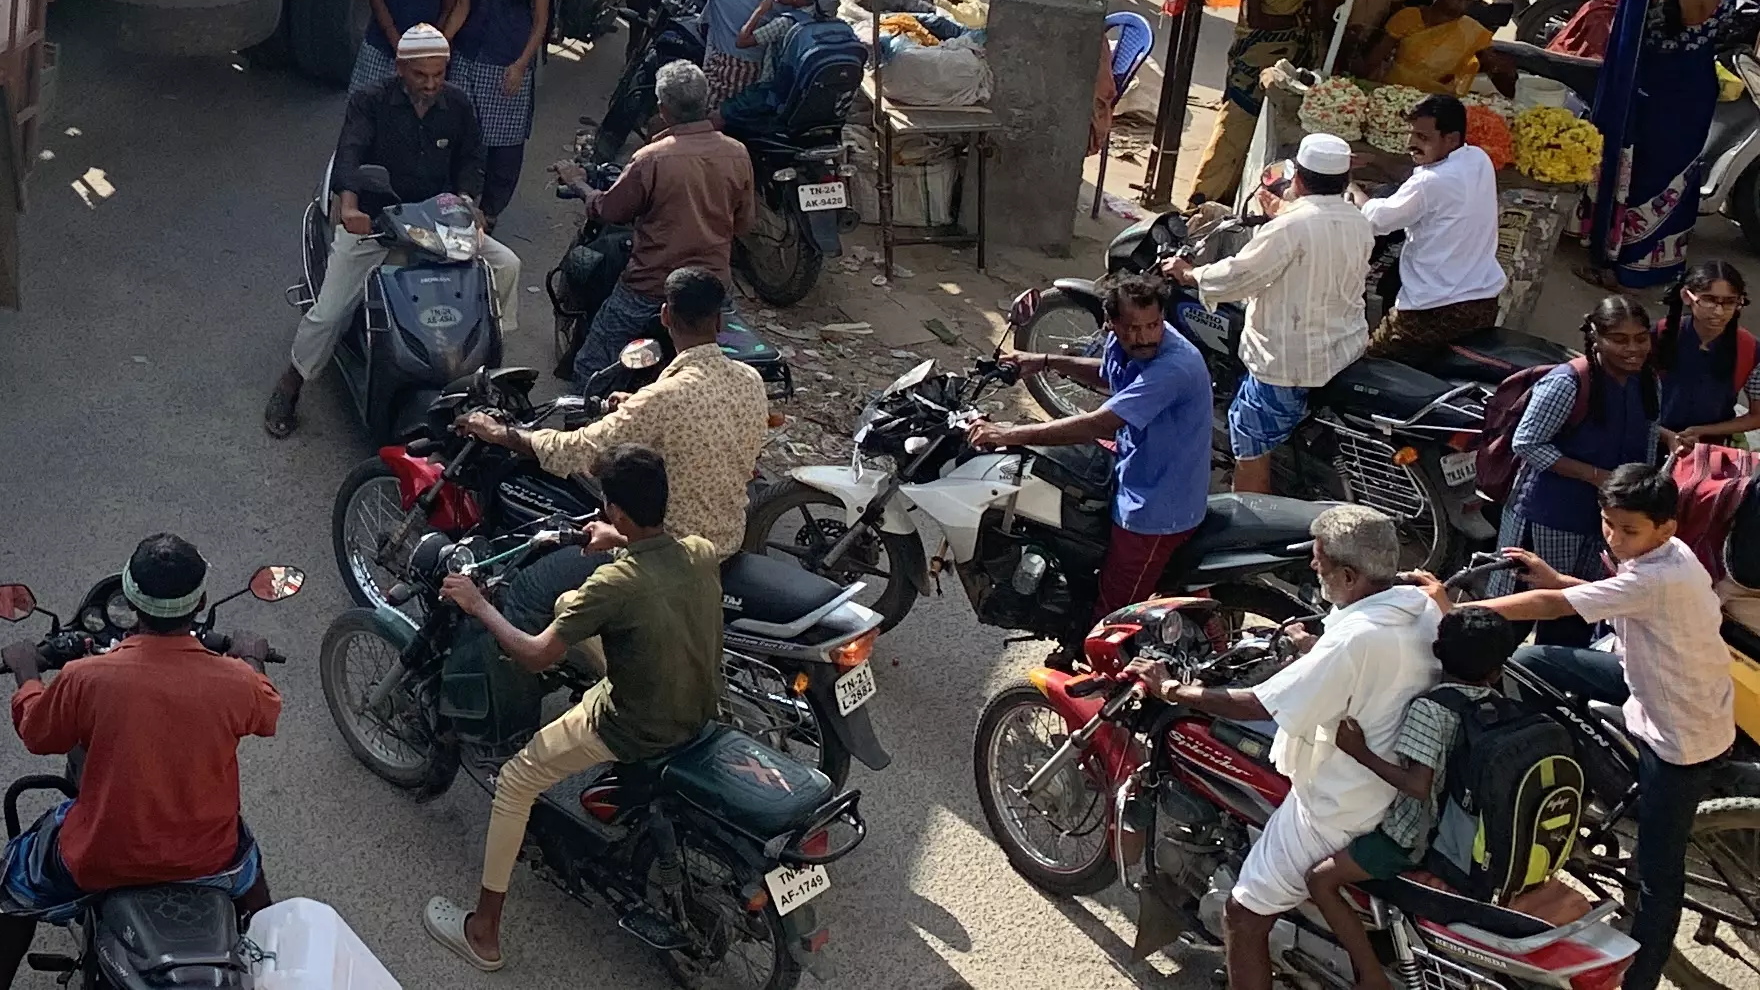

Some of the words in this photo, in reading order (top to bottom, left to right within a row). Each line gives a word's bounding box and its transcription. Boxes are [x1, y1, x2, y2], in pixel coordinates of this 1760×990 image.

[805, 196, 843, 208] AK-9420
[809, 185, 836, 195] TN-24
[1184, 311, 1226, 334] HONDA
[1186, 306, 1222, 325] HERO
[841, 669, 868, 695] TN-21
[1556, 706, 1610, 747] AVON
[1168, 729, 1254, 777] Splendor
[780, 874, 824, 907] AF-1749
[1435, 937, 1466, 955] HERO
[1467, 950, 1507, 969] HONDA
